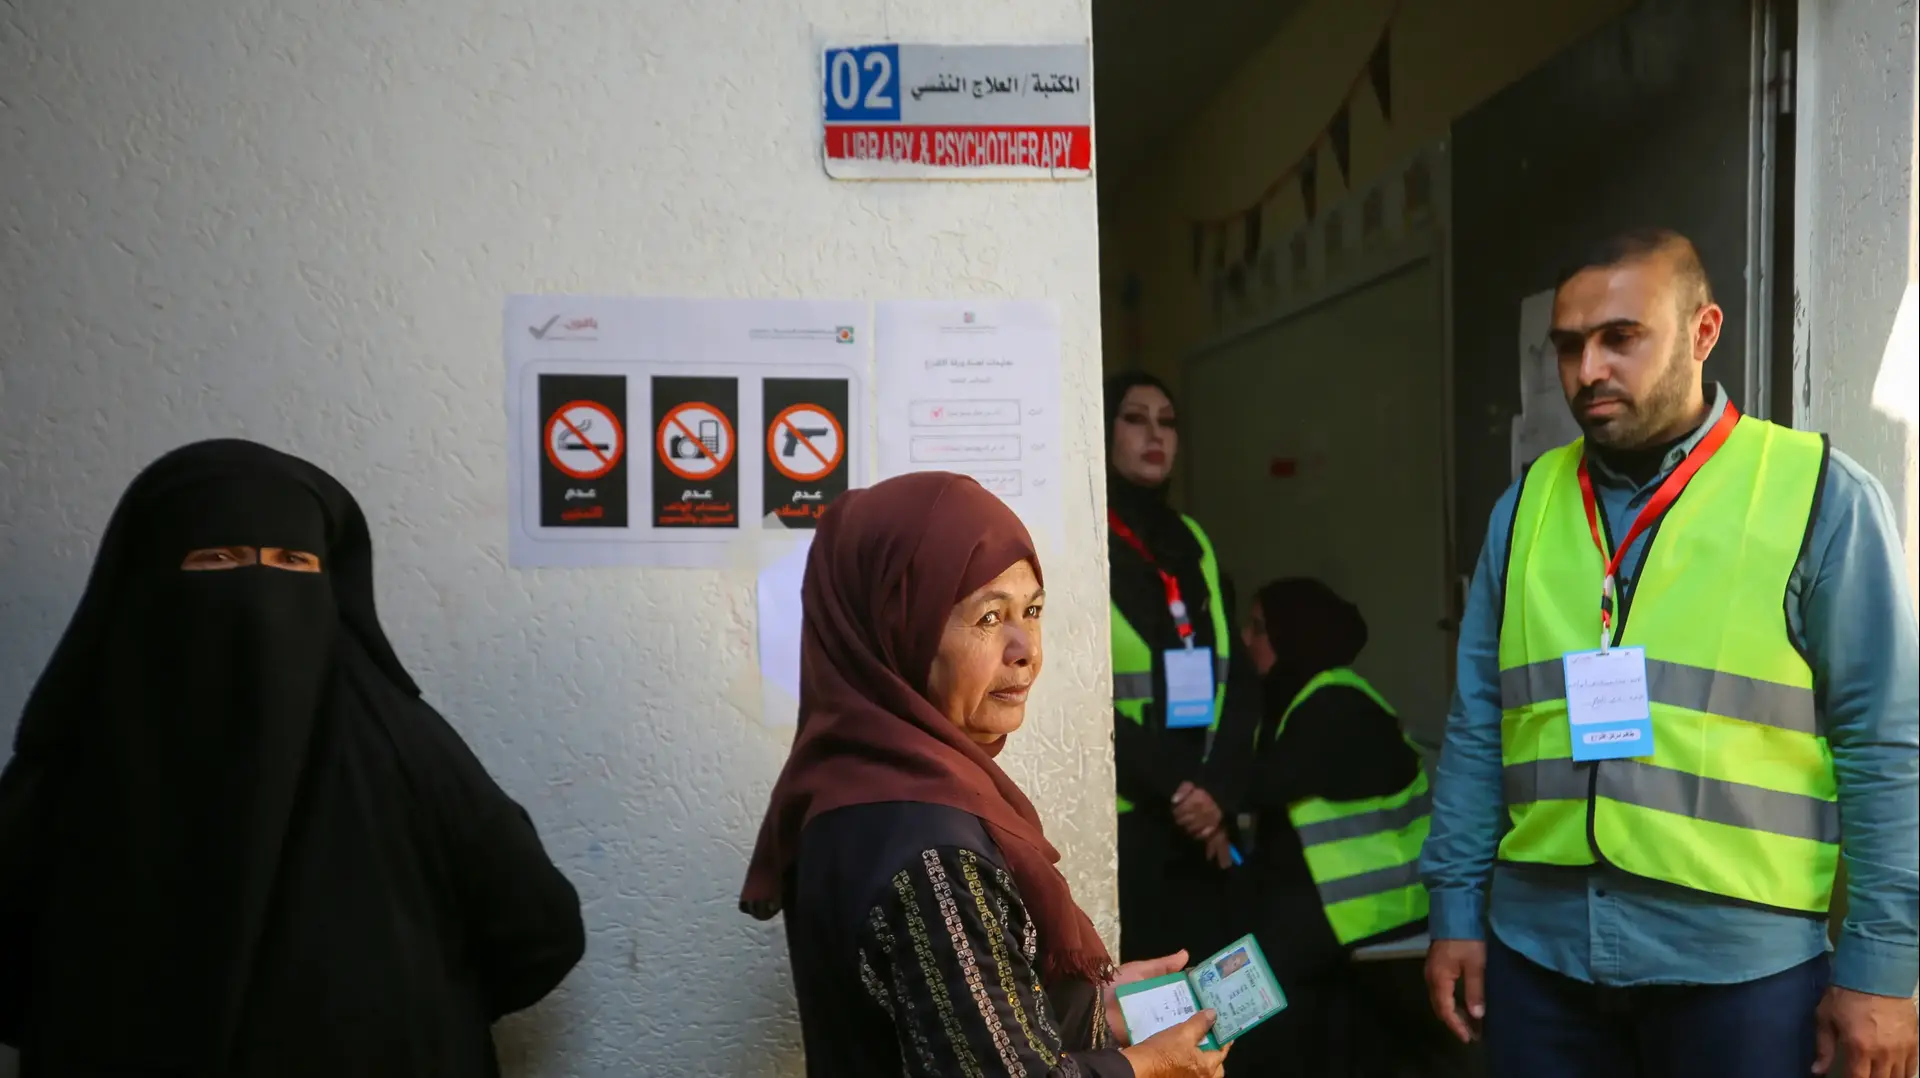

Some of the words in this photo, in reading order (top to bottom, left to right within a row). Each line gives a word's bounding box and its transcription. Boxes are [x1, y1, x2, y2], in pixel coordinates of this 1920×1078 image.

[831, 51, 893, 110] 02
[910, 73, 967, 101] النفسي
[972, 75, 1019, 98] العلاج
[1032, 74, 1080, 99] المكتبة
[935, 131, 1073, 168] PSYCHOTHERAPY
[564, 488, 597, 502] عدم
[681, 490, 713, 503] عدم
[792, 490, 823, 504] عدم
